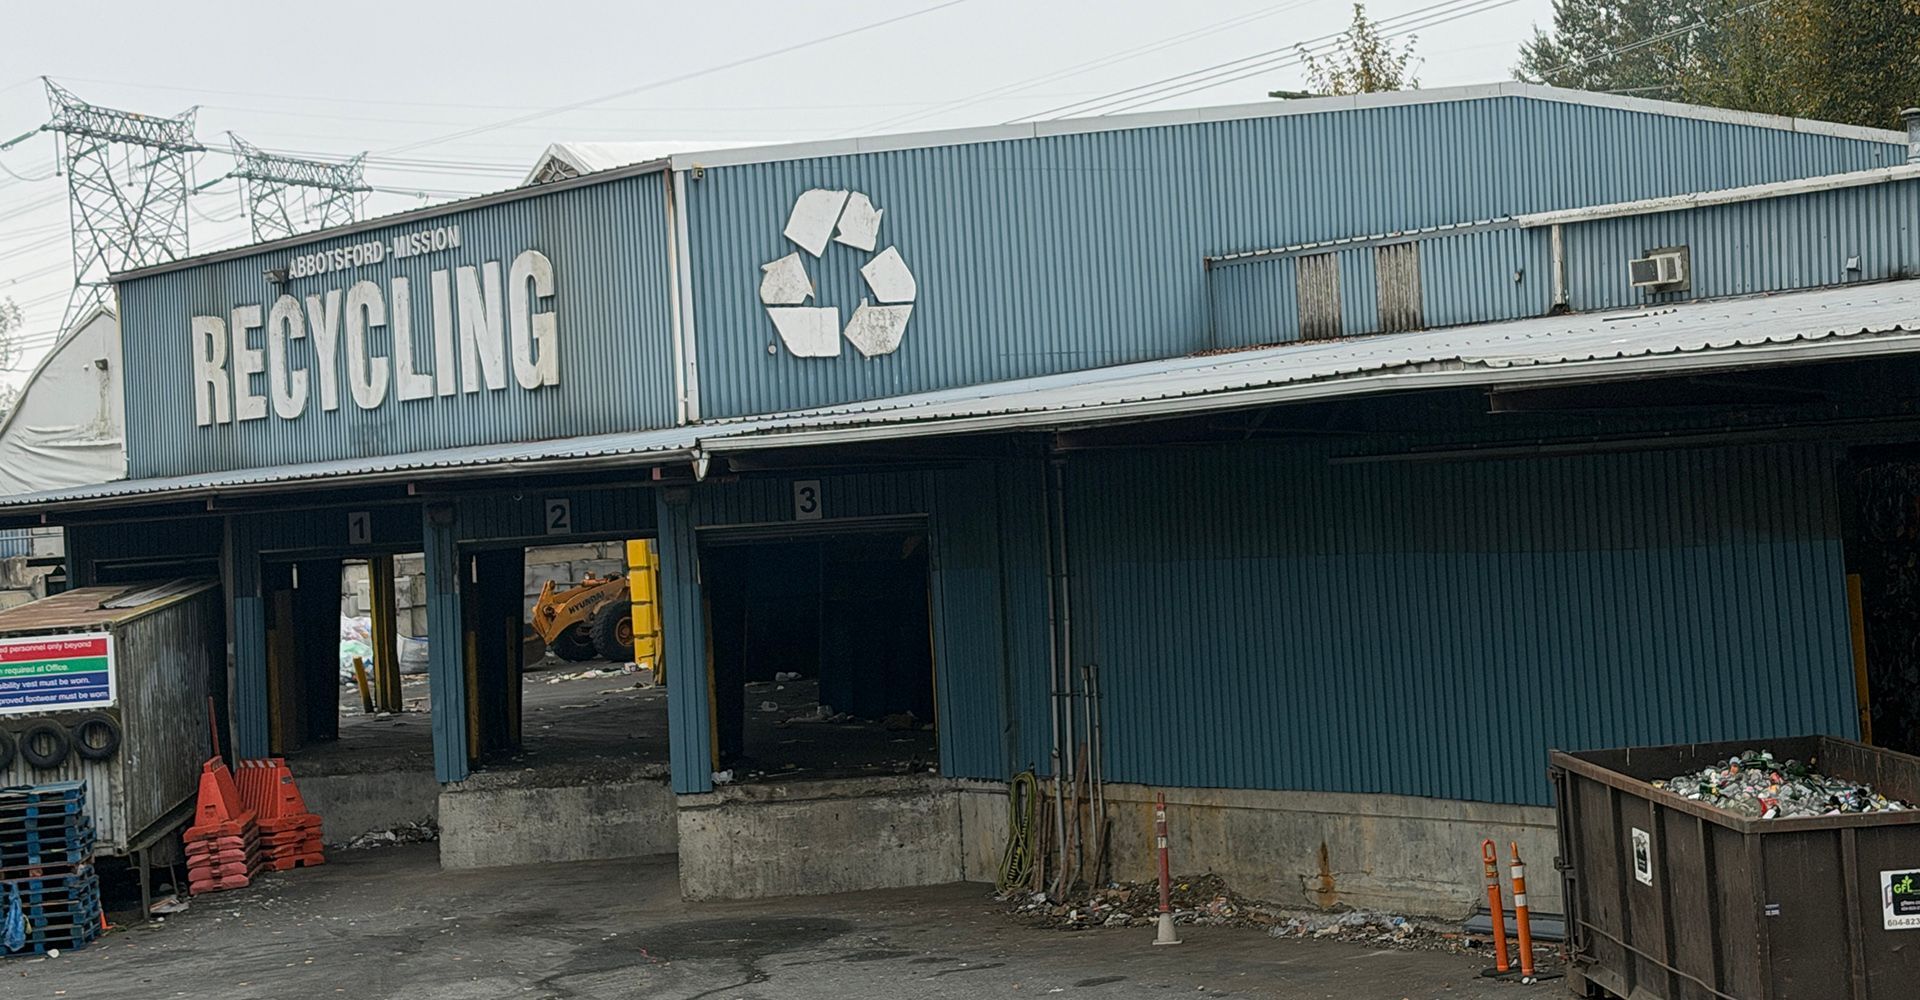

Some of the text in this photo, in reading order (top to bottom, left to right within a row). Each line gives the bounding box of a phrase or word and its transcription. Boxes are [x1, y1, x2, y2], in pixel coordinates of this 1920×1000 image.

[192, 249, 559, 426] RECYCLING
[800, 487, 817, 513] 3
[550, 504, 567, 529] 2
[353, 517, 364, 539] 1
[568, 591, 604, 614] HYUNDAI
[9, 644, 46, 654] personnel
[47, 643, 63, 651] only
[64, 641, 92, 650] beyond
[4, 666, 35, 675] required
[45, 664, 69, 672] Office.
[25, 695, 57, 703] footwear
[1893, 877, 1913, 894] GFL
